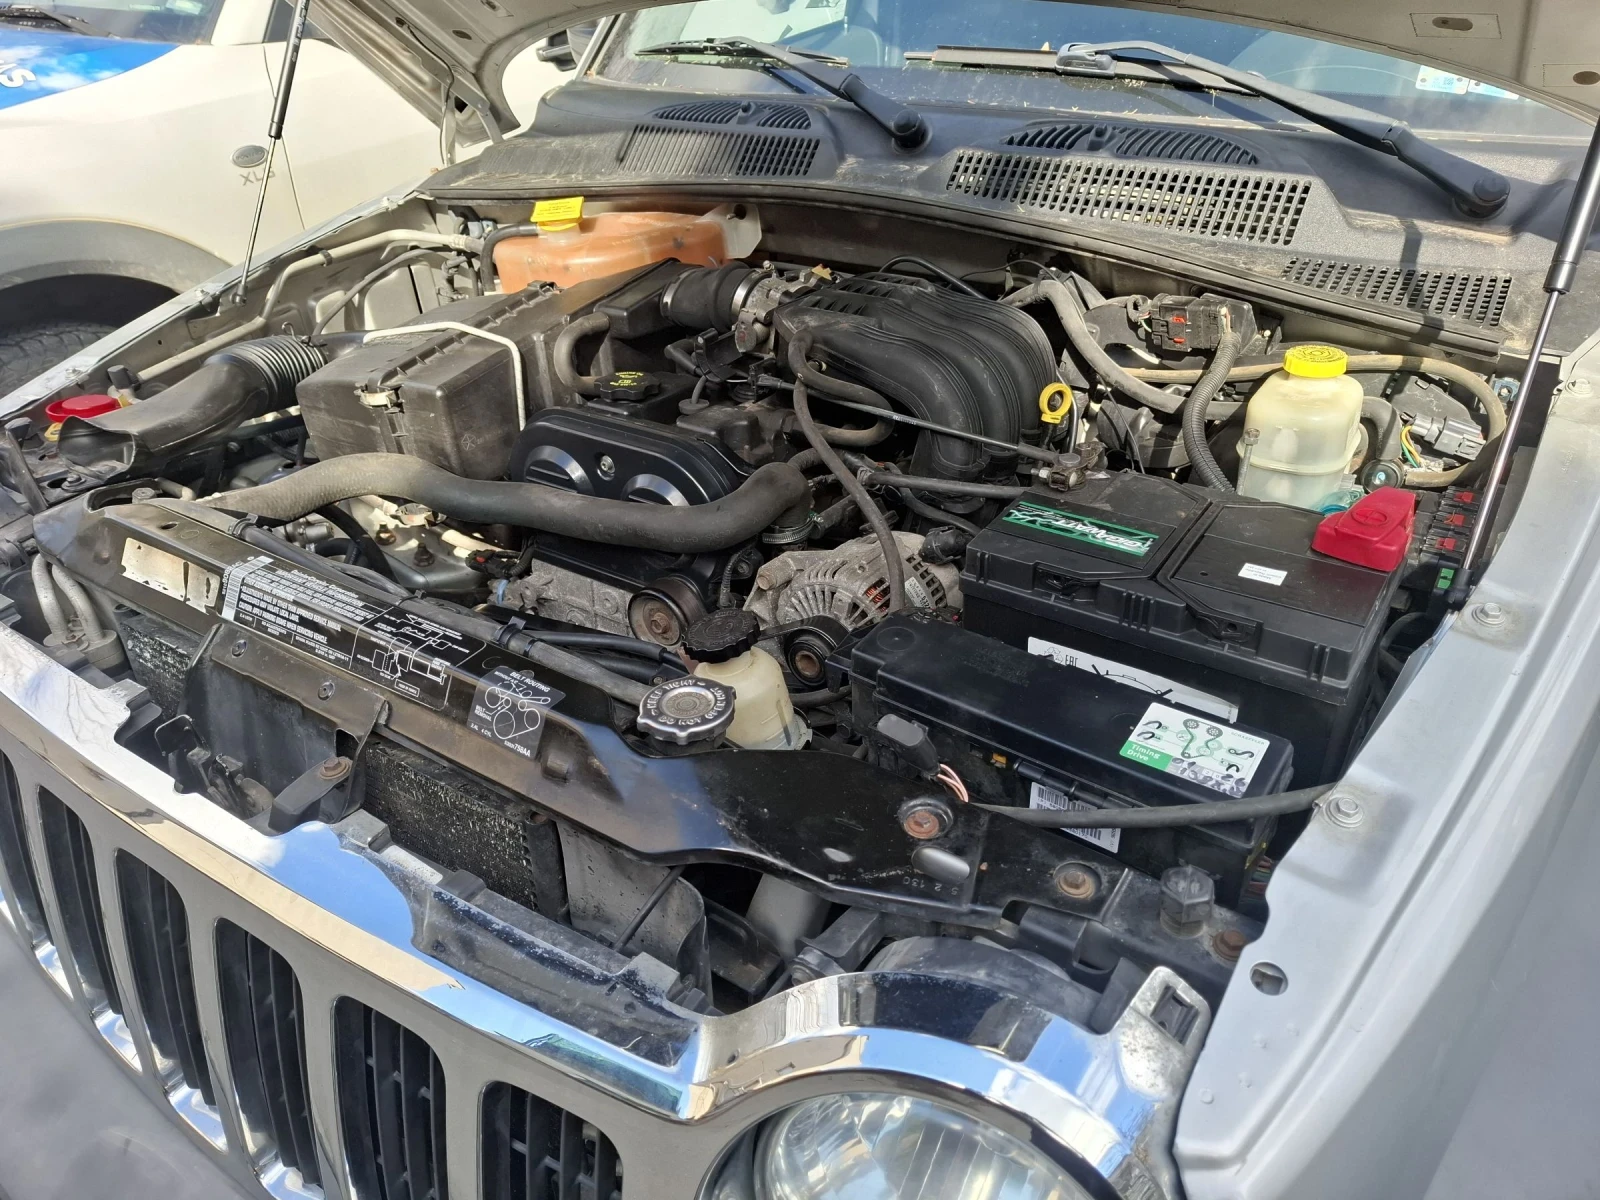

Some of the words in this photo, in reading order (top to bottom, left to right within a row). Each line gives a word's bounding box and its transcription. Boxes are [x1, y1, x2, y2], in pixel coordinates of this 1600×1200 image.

[509, 671, 526, 681] BELT
[525, 677, 550, 692] ROUTING
[1127, 749, 1149, 762] Drive
[1131, 744, 1161, 760] Timing
